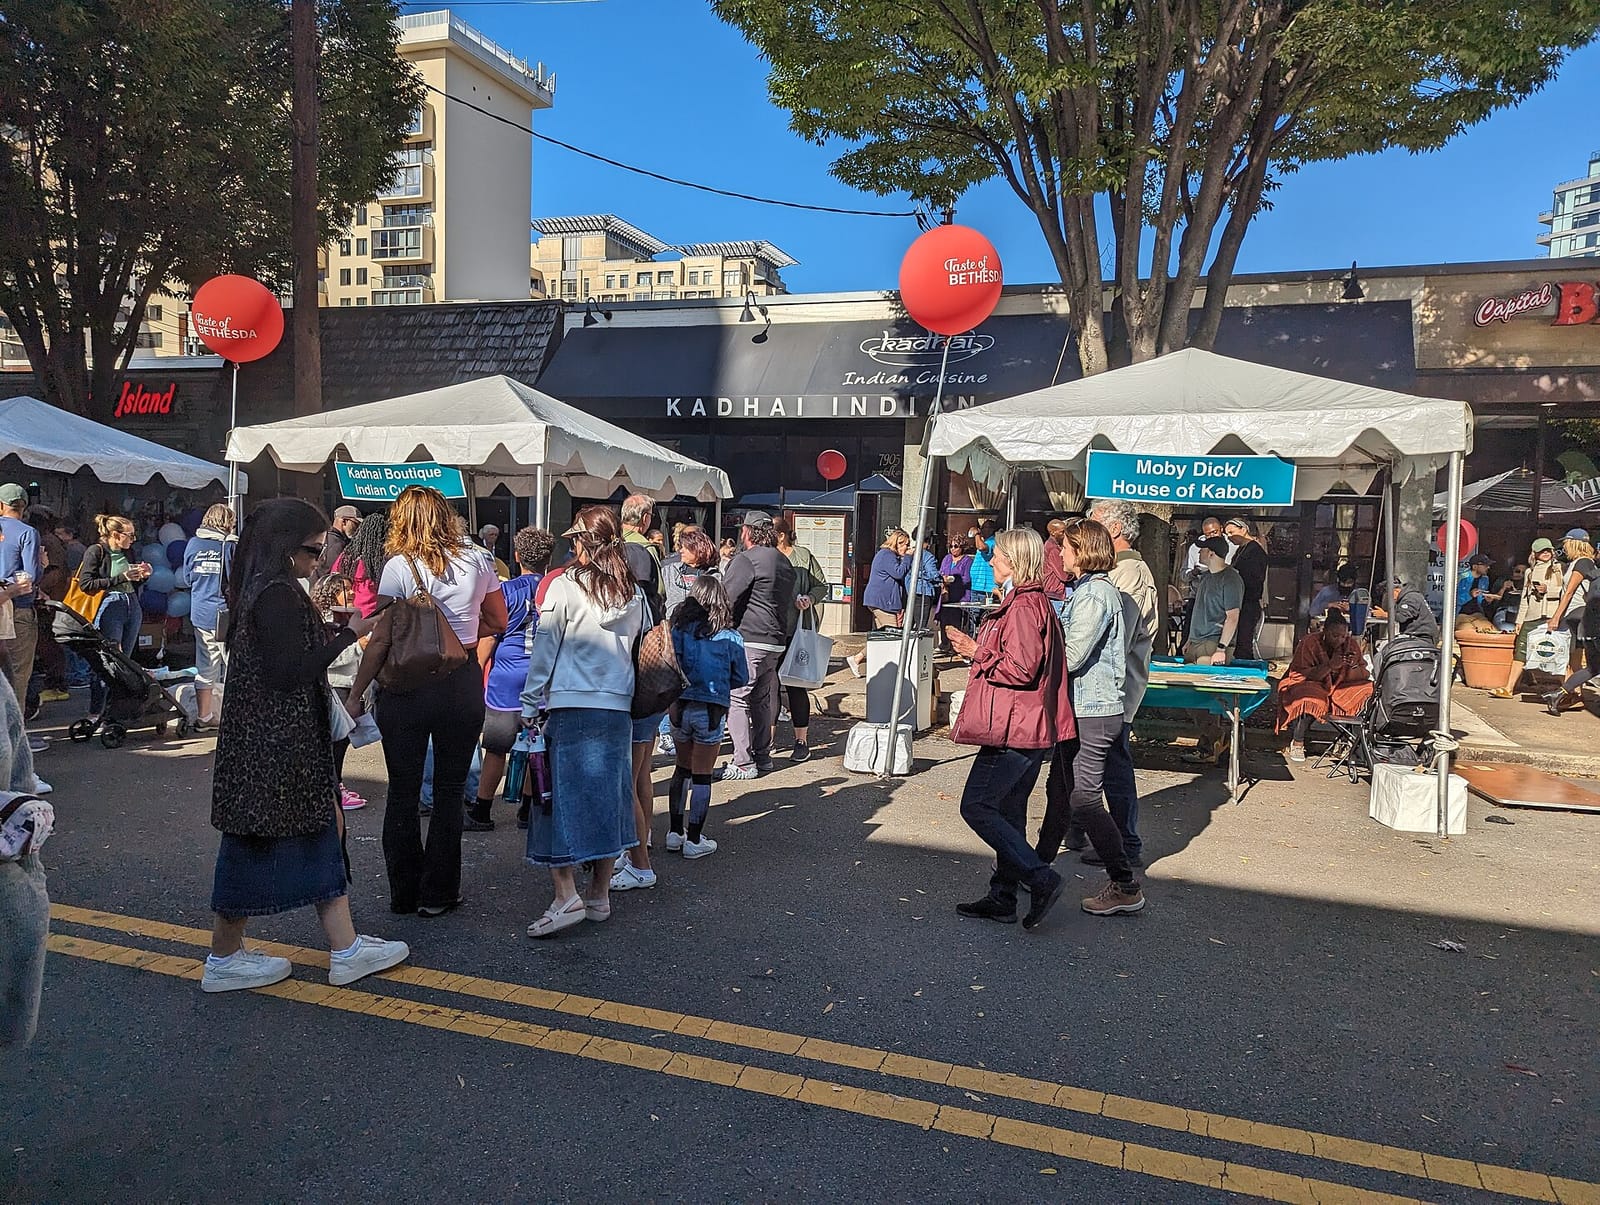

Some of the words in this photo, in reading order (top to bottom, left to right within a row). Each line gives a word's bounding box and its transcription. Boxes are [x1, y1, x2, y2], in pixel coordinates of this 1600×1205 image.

[944, 258, 977, 273] Taste
[978, 255, 988, 273] of
[1475, 283, 1552, 326] Capital
[1550, 281, 1600, 327] B
[195, 312, 218, 328] Taste
[218, 316, 232, 335] of
[198, 324, 257, 339] BETHESDA
[842, 371, 909, 386] Indian
[916, 370, 988, 384] Cuisine
[114, 381, 176, 418] Island
[666, 397, 802, 416] KADHAI
[832, 395, 975, 416] INDIAN
[347, 467, 382, 480] Kadhai
[384, 468, 442, 481] Boutique
[1136, 459, 1187, 480] Moby
[1193, 461, 1243, 478] Dick/
[355, 484, 387, 496] Indian
[1112, 480, 1170, 497] House
[1175, 484, 1196, 498] of
[1201, 483, 1264, 500] Kabob
